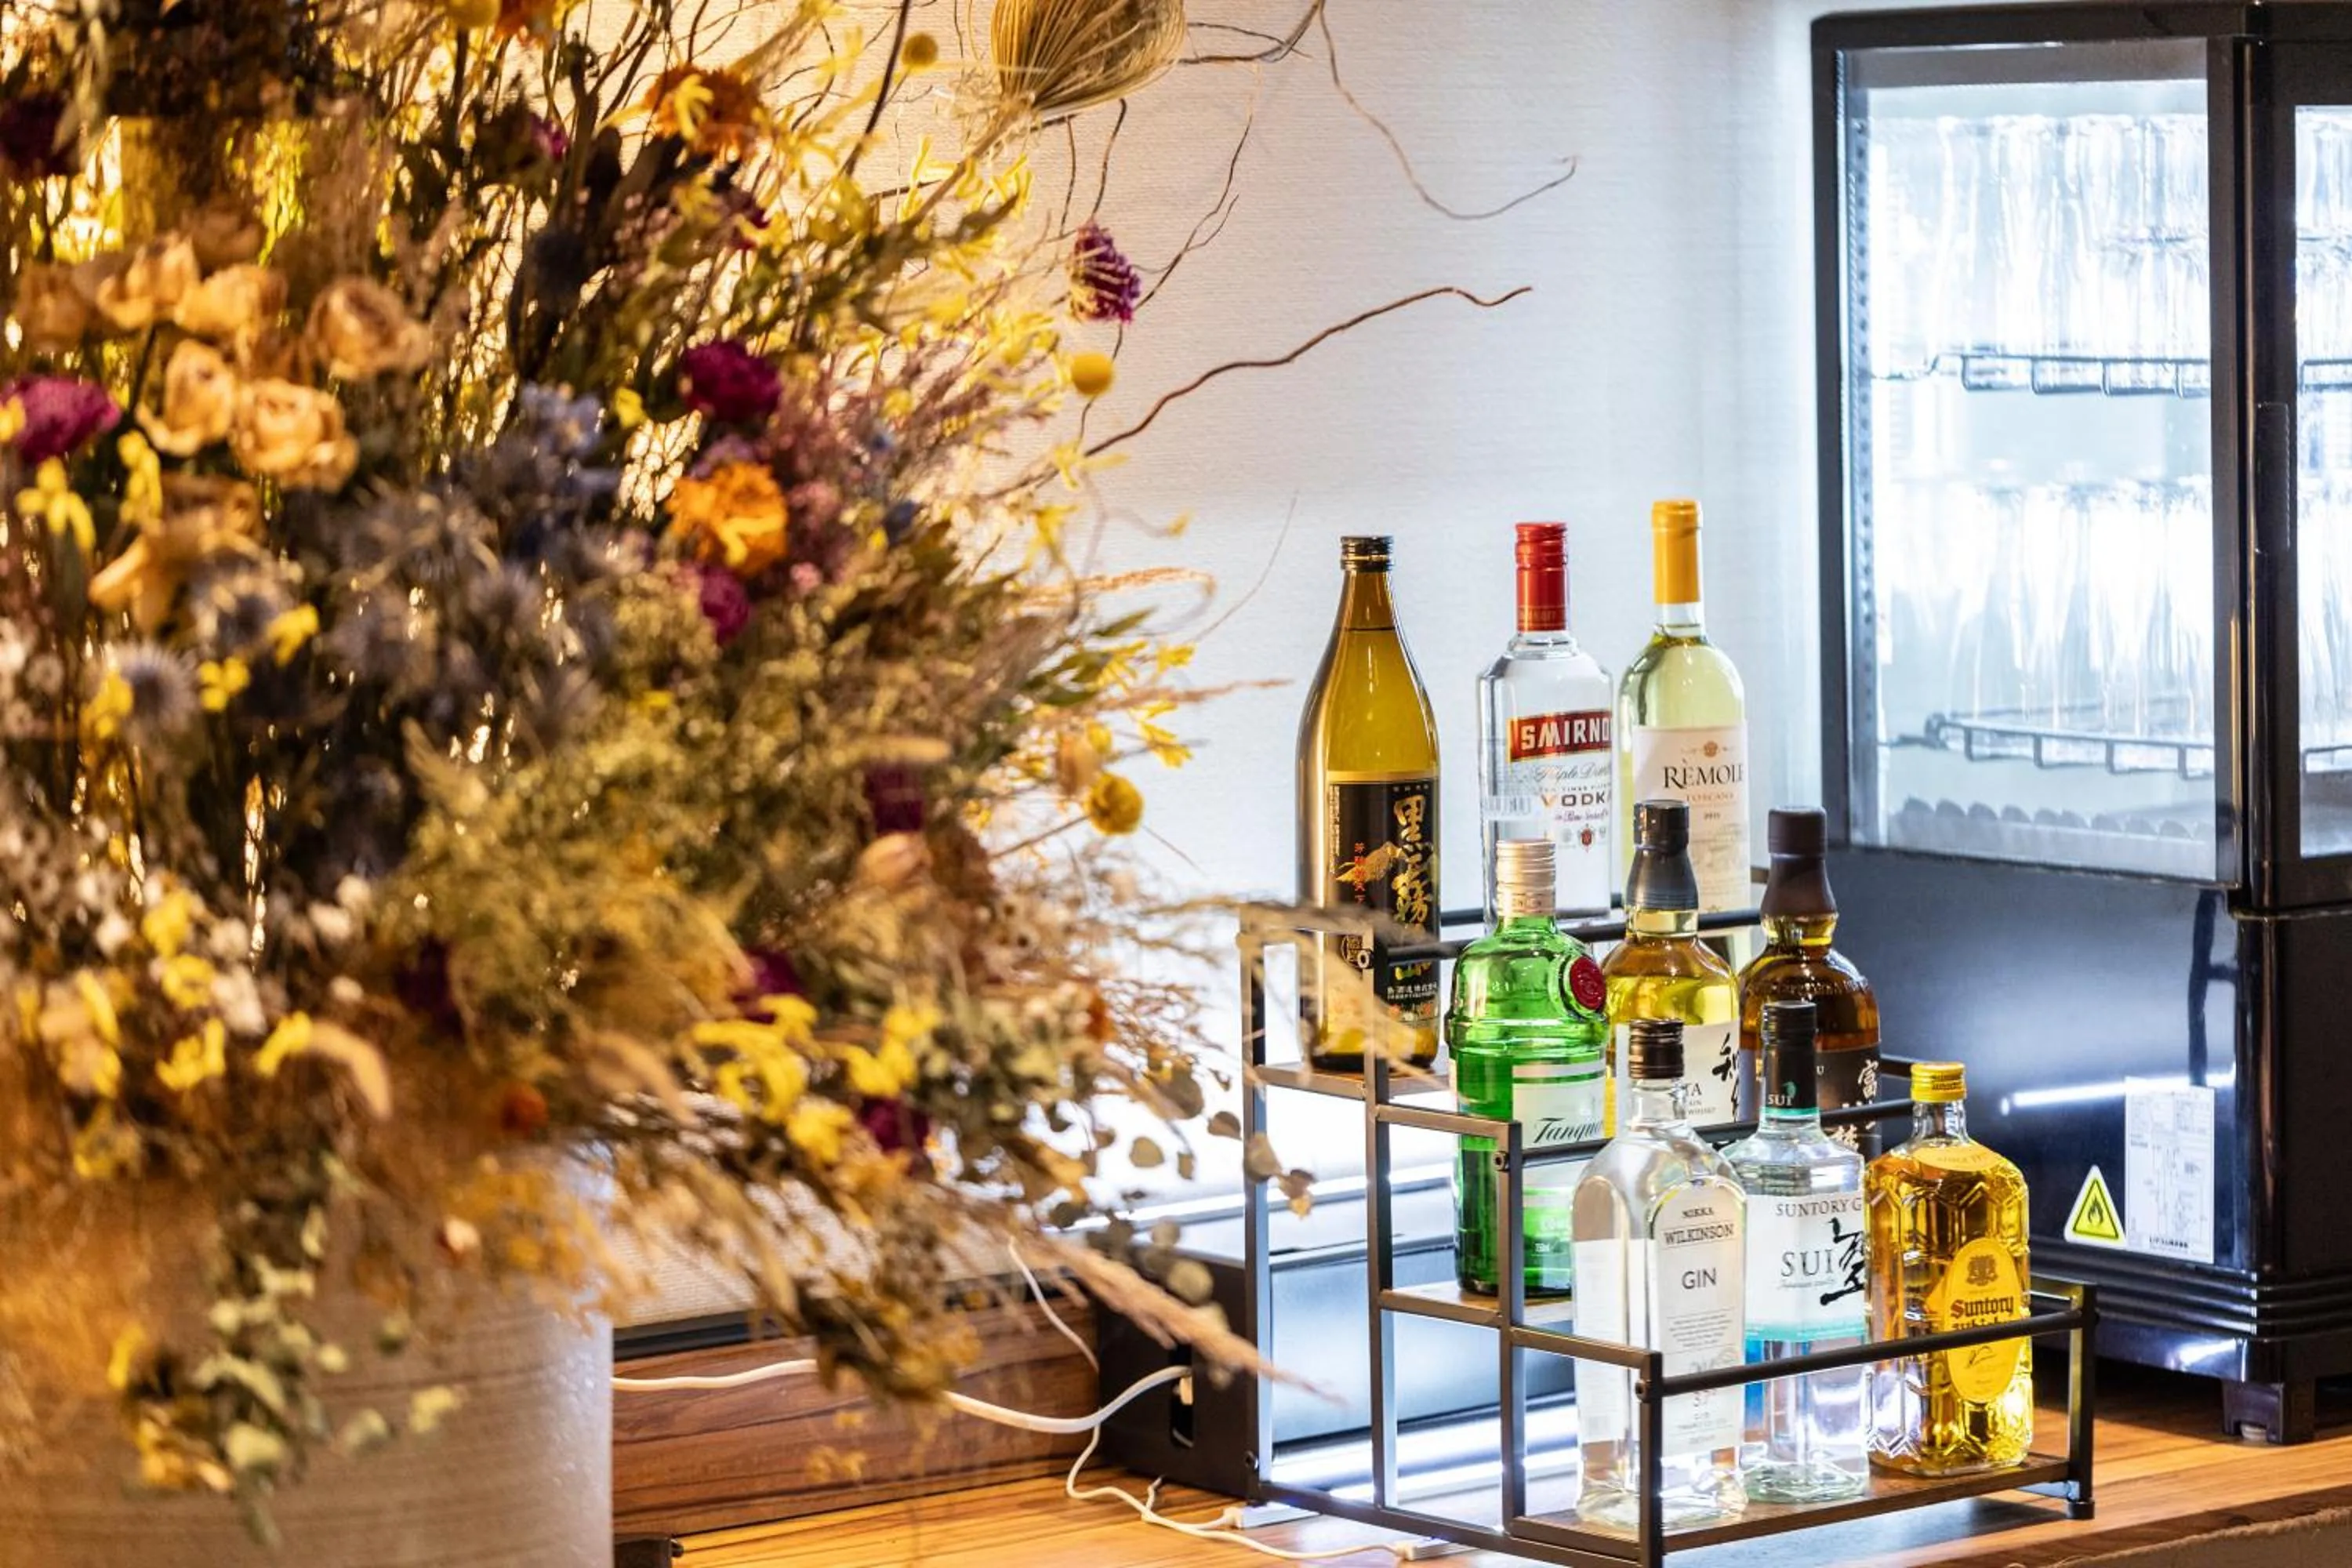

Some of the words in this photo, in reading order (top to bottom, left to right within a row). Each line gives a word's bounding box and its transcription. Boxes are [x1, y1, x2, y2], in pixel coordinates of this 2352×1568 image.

[1392, 795, 1434, 980] 黒霧
[1768, 1094, 1793, 1106] SUI
[1682, 1207, 1715, 1218] NIKKA
[1776, 1200, 1849, 1217] SUNTORY
[1664, 1224, 1734, 1245] WILKINSON
[1780, 1249, 1834, 1277] SUI
[1682, 1268, 1717, 1290] GIN
[1951, 1295, 2014, 1319] Suntory
